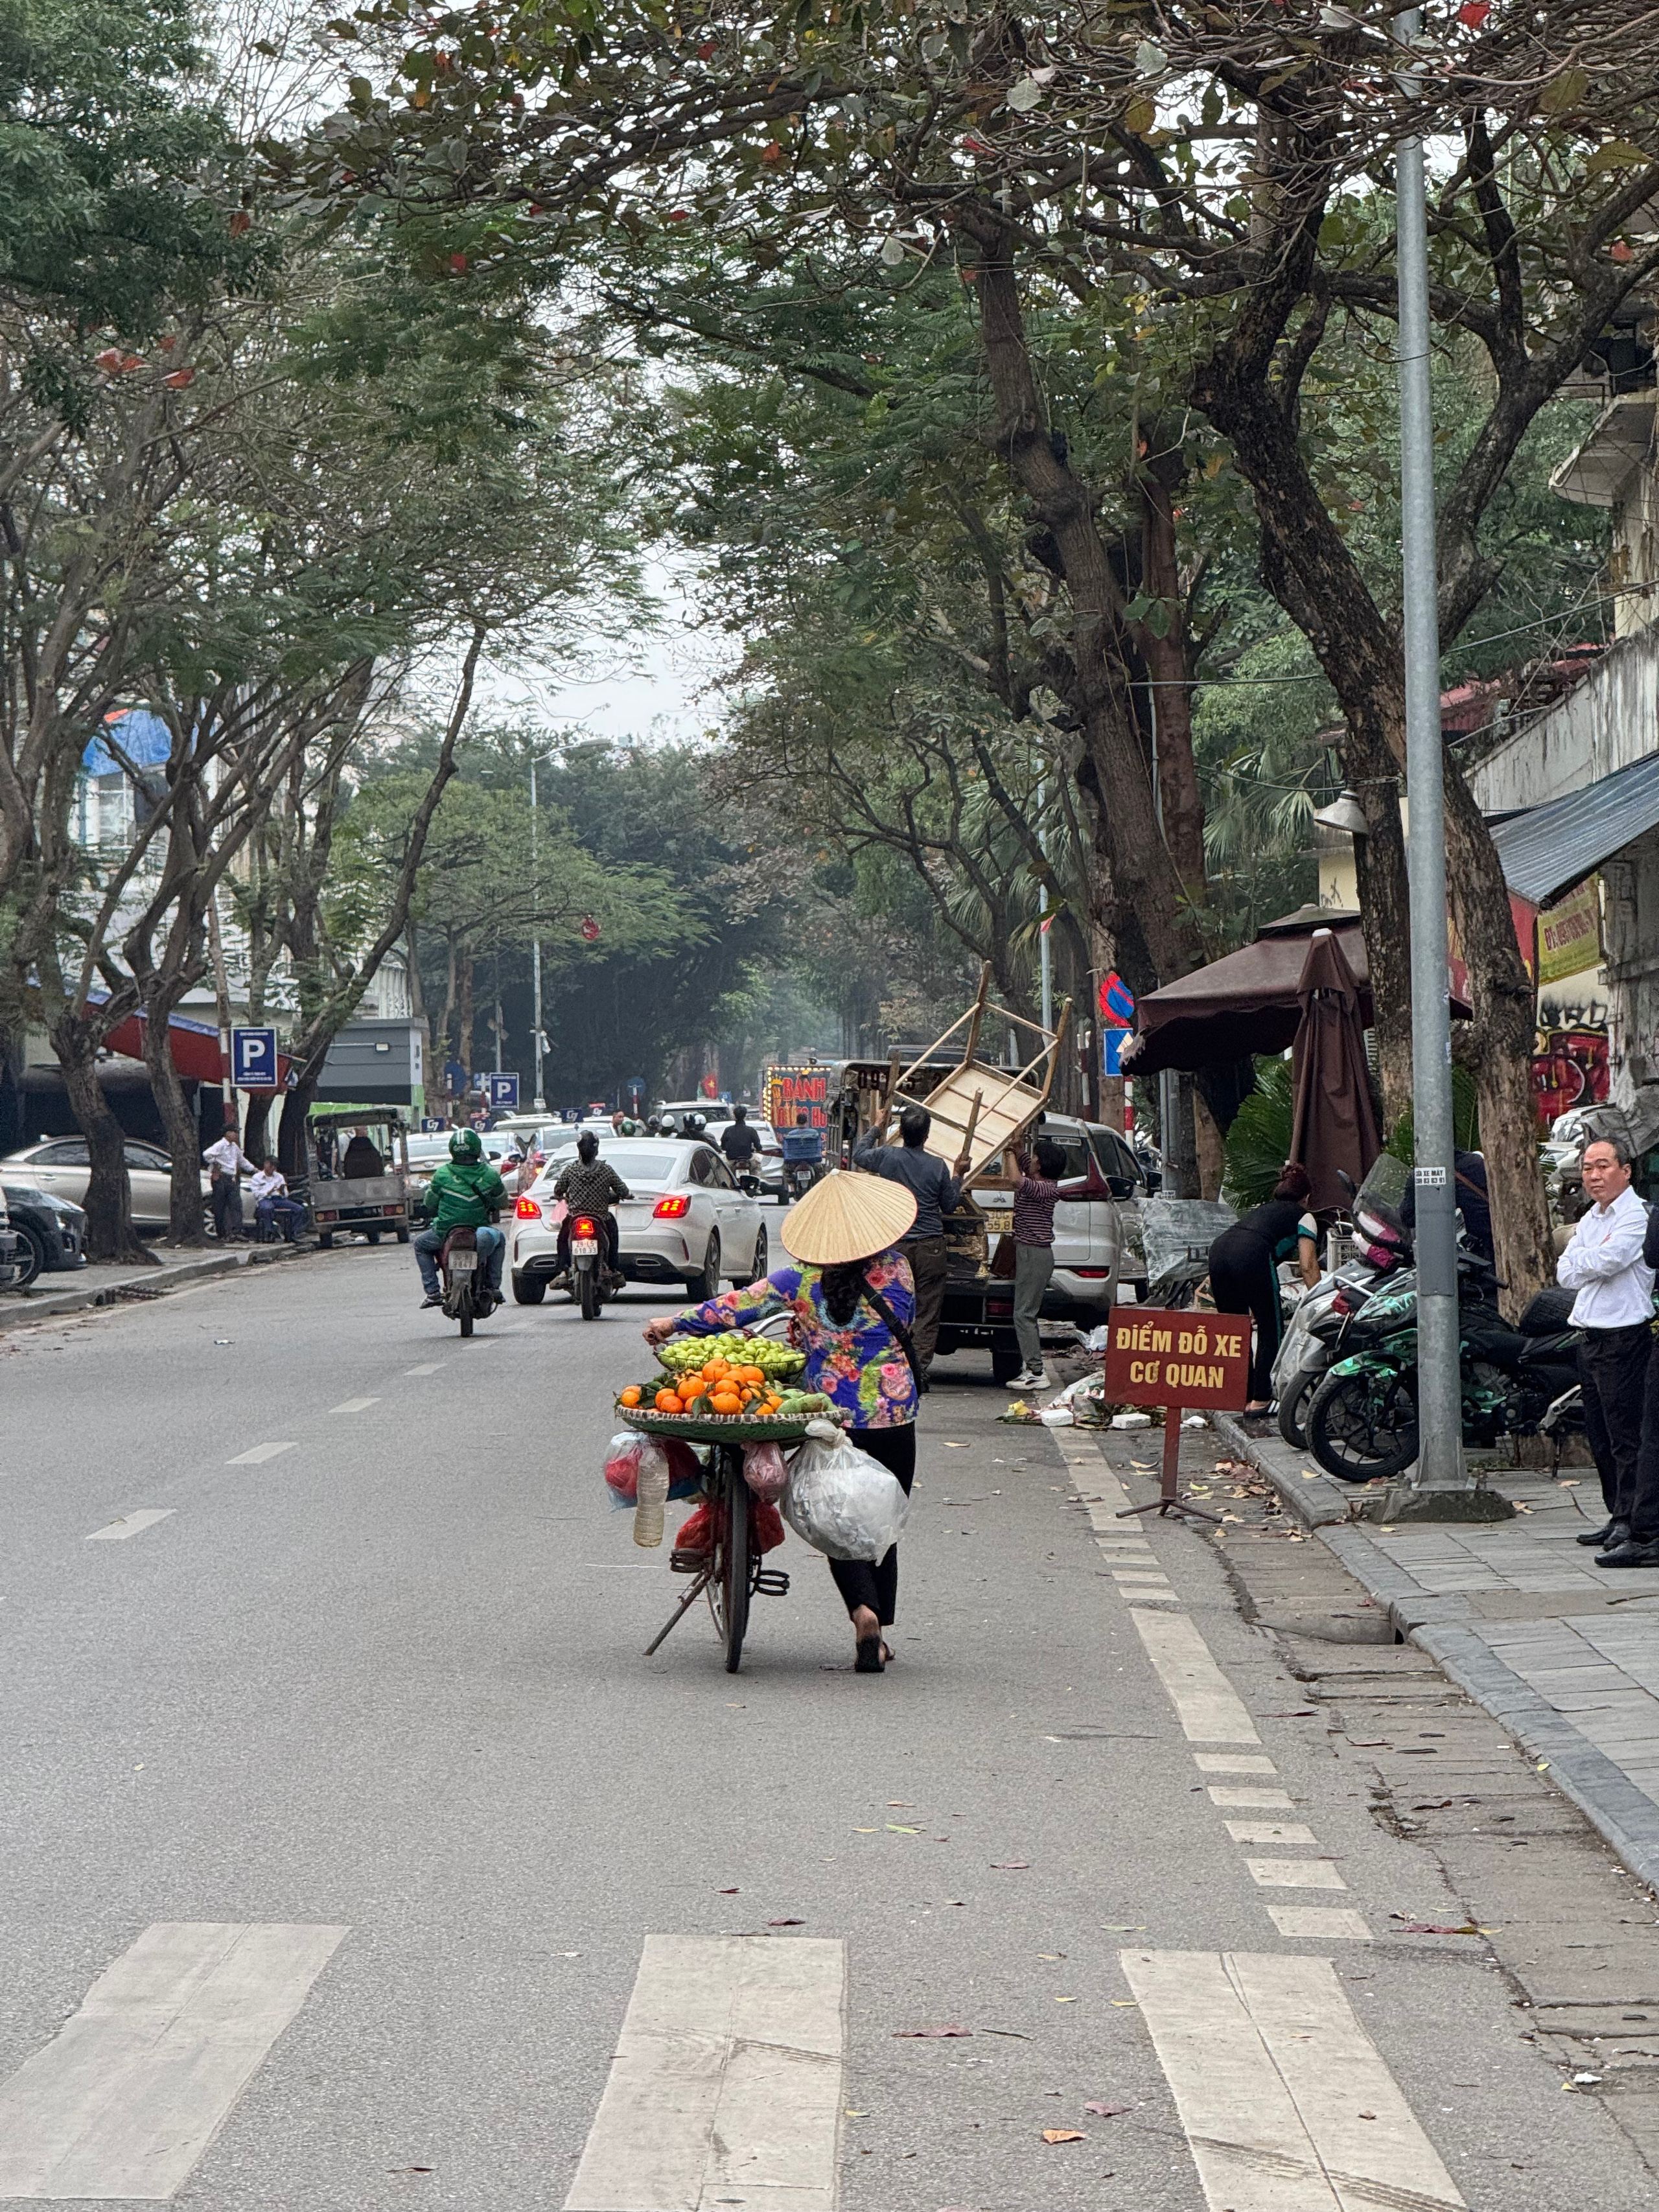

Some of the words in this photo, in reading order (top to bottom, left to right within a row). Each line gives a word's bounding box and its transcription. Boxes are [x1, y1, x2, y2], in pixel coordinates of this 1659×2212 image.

[242, 1040, 265, 1067] P
[497, 1082, 511, 1099] P
[426, 1119, 439, 1130] G7
[566, 1110, 579, 1122] G7
[474, 1121, 485, 1131] G7
[1178, 1325, 1207, 1355] ĐỖ
[1214, 1334, 1242, 1358] XE
[1130, 1360, 1160, 1384] CƠ
[1166, 1363, 1224, 1388] QUAN
